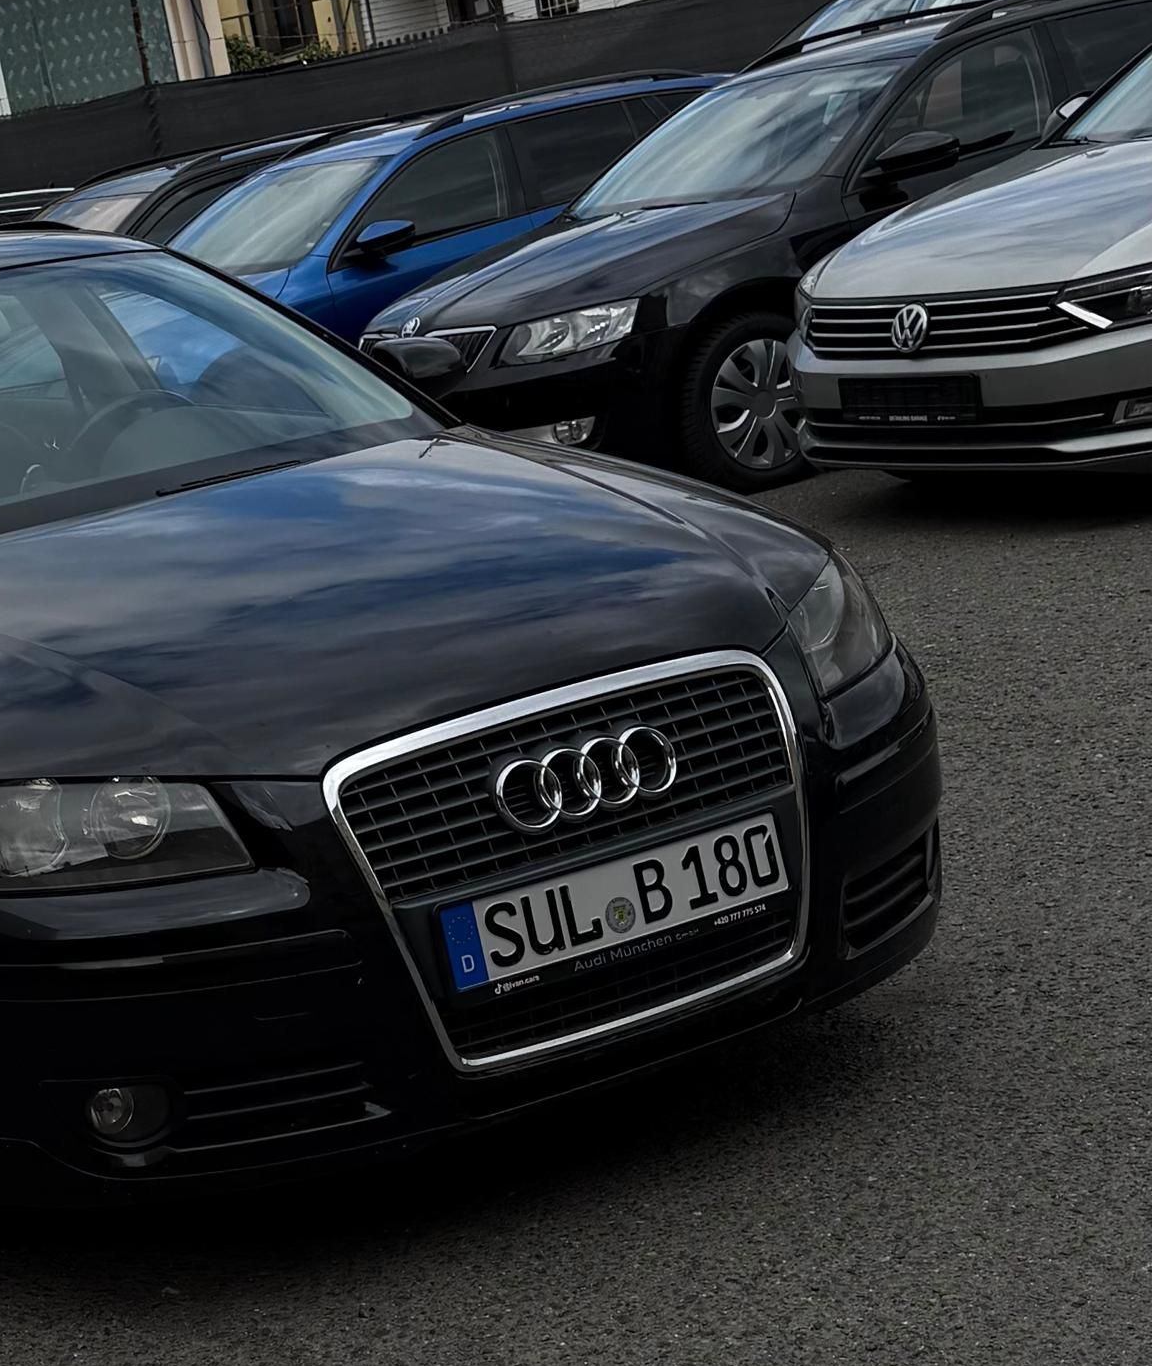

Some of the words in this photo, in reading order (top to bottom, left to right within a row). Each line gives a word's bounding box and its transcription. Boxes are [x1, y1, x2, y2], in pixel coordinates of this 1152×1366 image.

[484, 885, 604, 967] SUL
[633, 858, 673, 924] B
[681, 824, 780, 910] 180
[714, 915, 729, 926] +420
[461, 954, 476, 973] D
[574, 954, 607, 972] Audi
[610, 935, 673, 961] München
